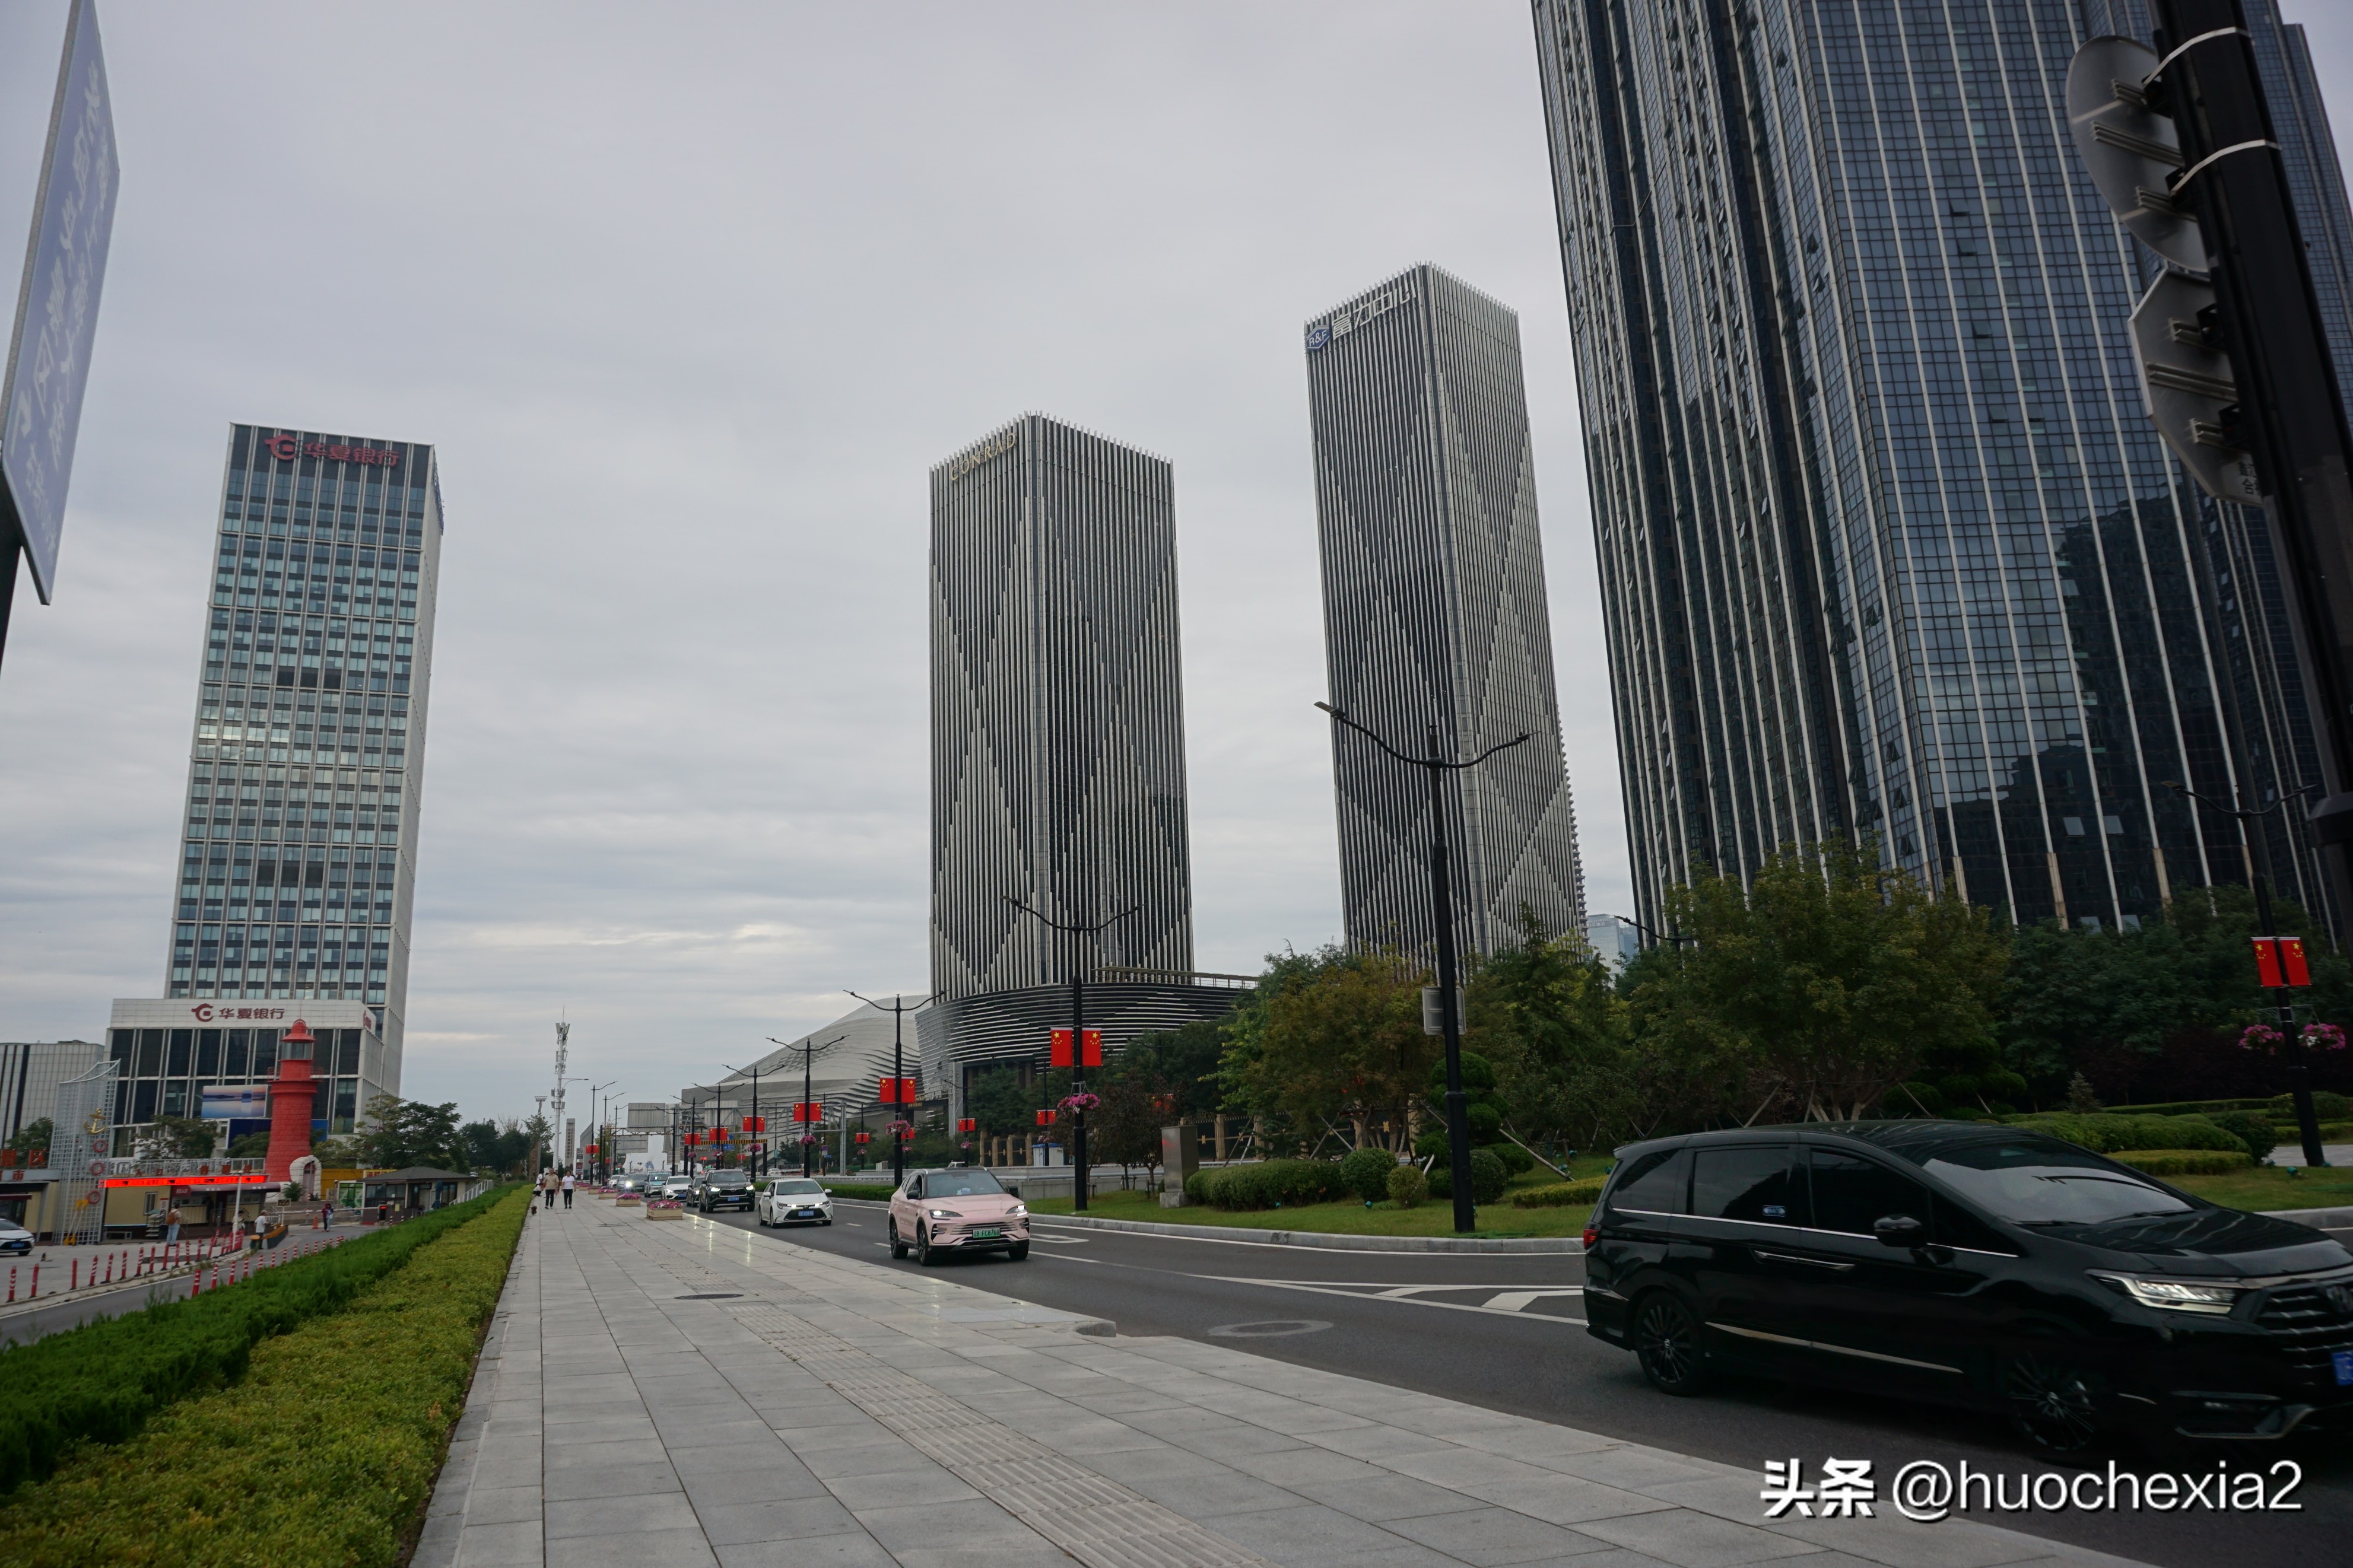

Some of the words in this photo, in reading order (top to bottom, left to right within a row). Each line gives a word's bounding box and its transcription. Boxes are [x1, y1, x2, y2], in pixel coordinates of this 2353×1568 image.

[33, 57, 102, 422] 老码头景区
[47, 122, 111, 475] 海上游大连
[1332, 280, 1417, 339] 富力中心
[1309, 329, 1328, 347] R&F
[304, 441, 399, 466] 华夏银行
[950, 431, 1017, 481] CONRAD
[218, 1007, 285, 1019] 华夏银行
